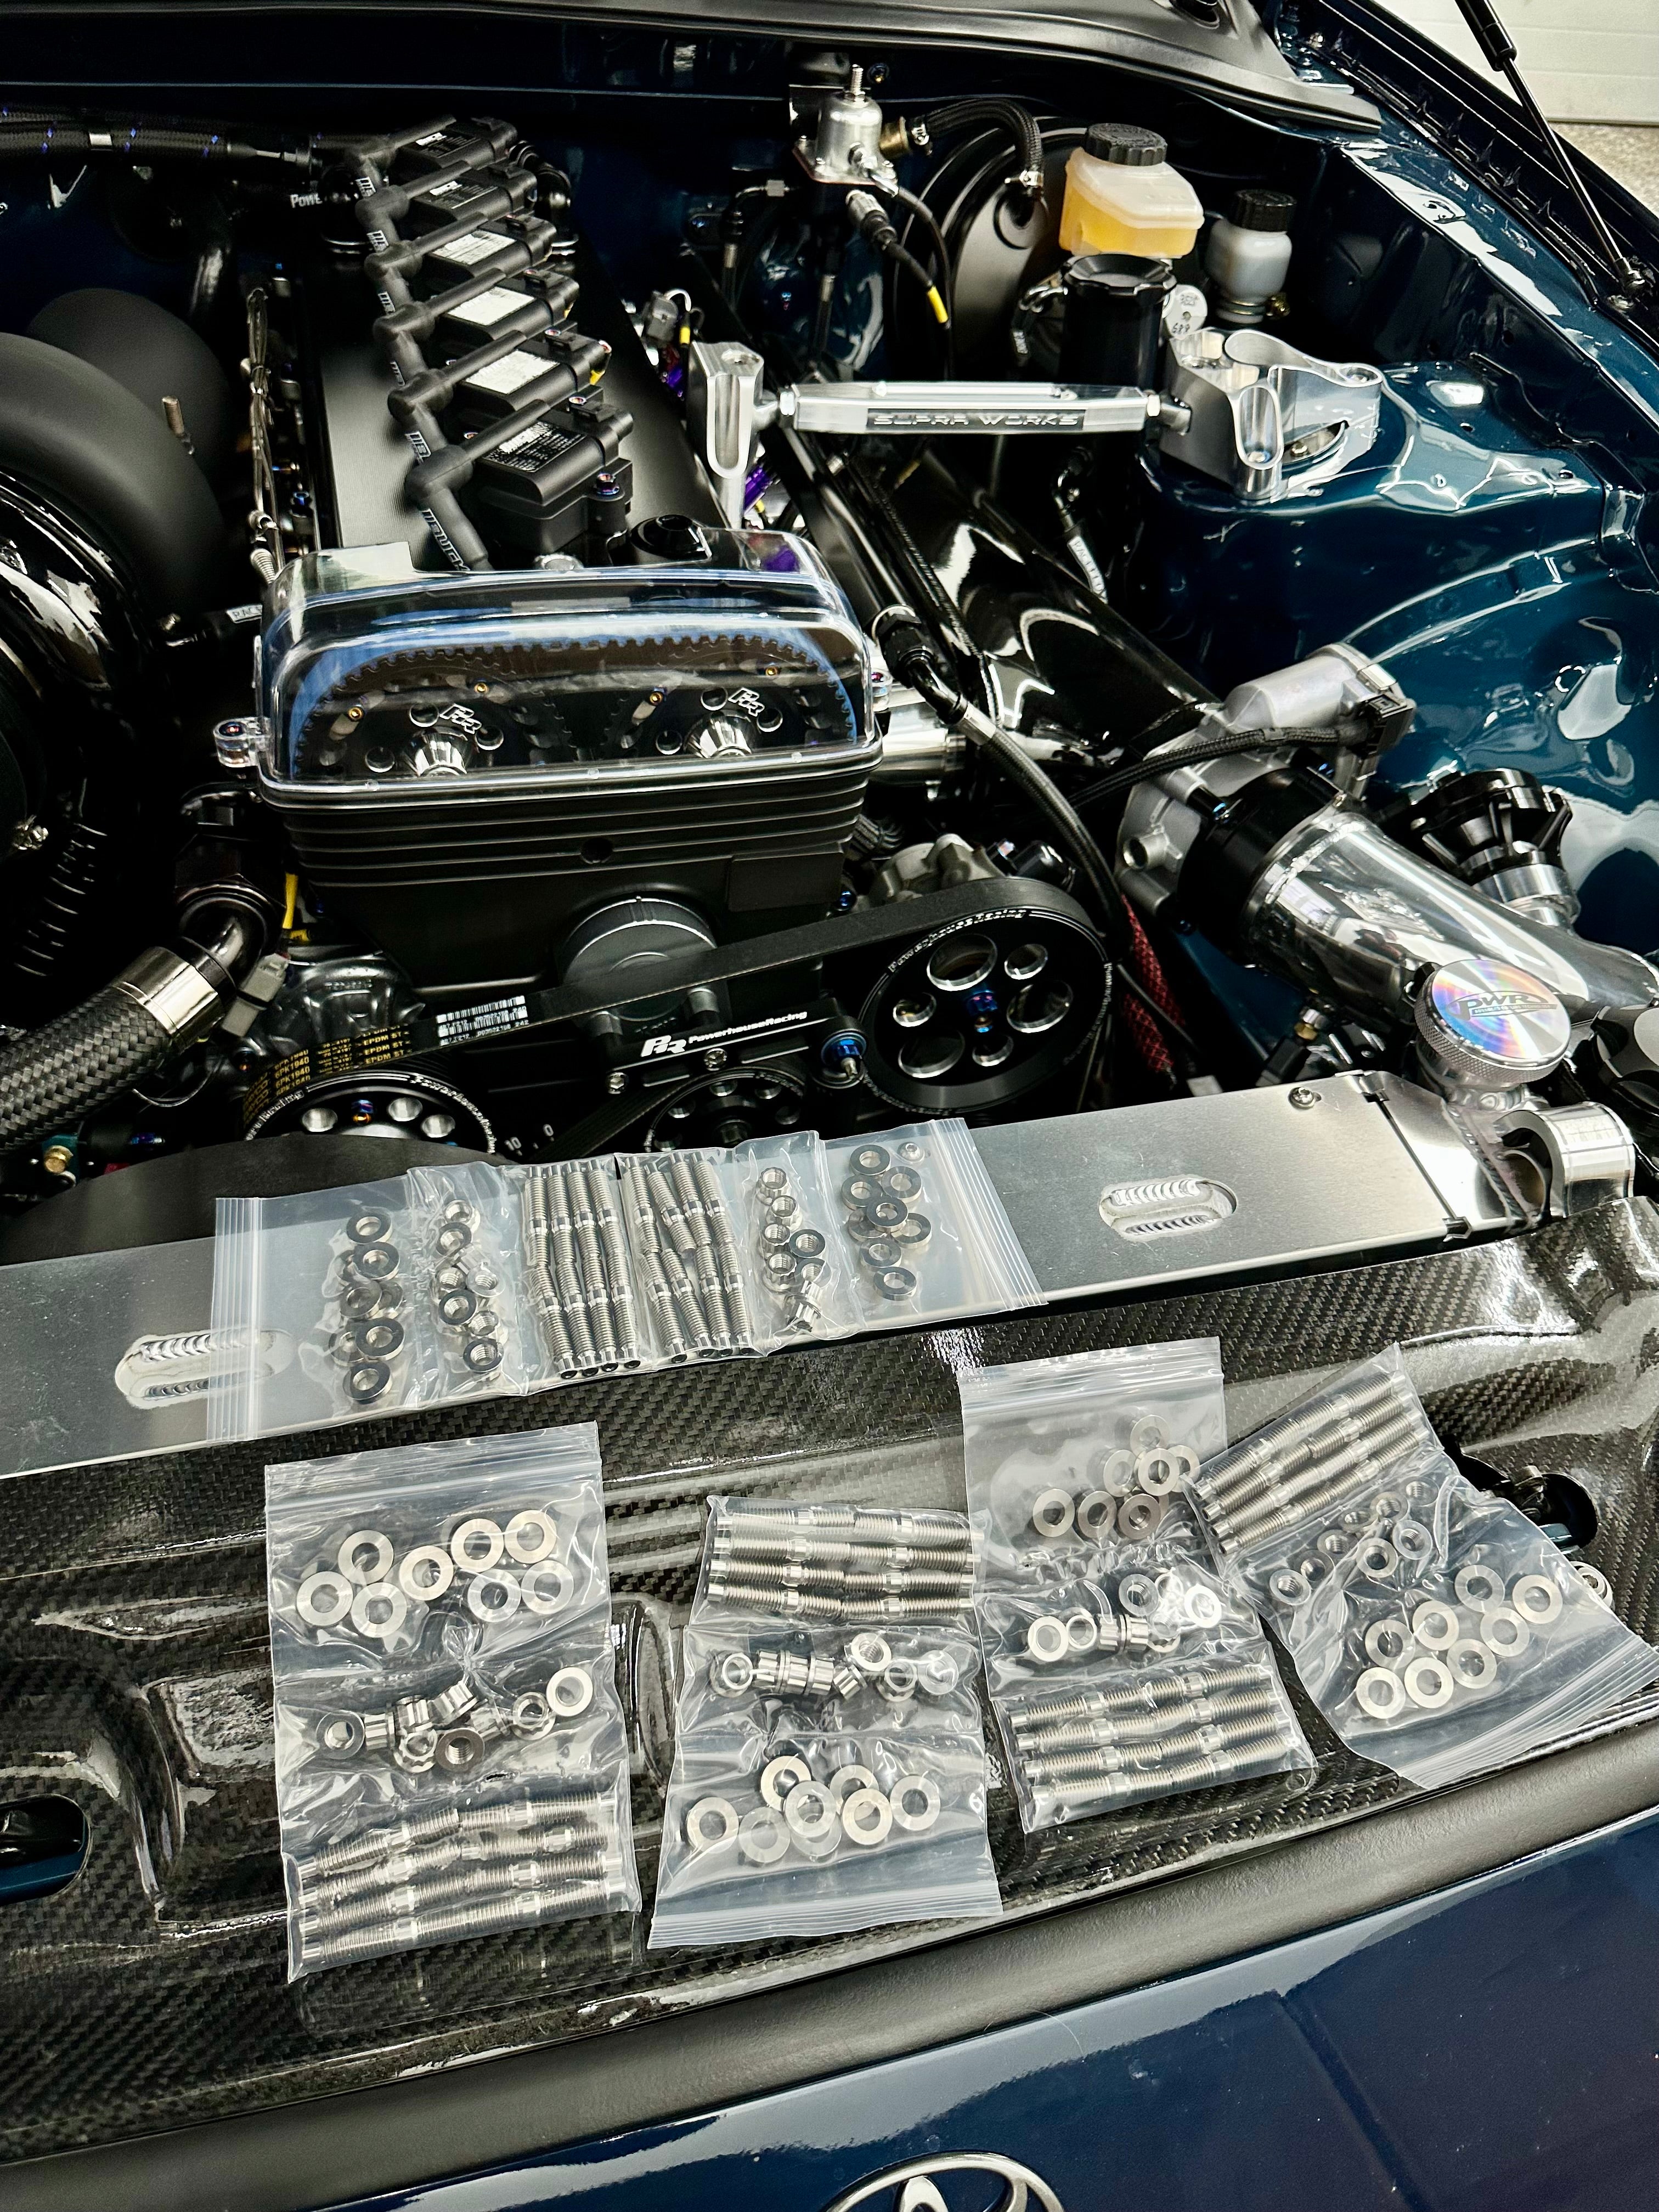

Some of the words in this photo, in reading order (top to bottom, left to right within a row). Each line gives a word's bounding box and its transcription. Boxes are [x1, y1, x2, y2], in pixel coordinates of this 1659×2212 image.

[874, 414, 969, 426] SUPRA
[979, 414, 1079, 426] WORKS
[1457, 994, 1549, 1021] PWR
[363, 1035, 389, 1046] EPDM
[364, 1044, 390, 1055] EPDM
[365, 1053, 391, 1064] EPDM
[275, 1056, 309, 1079] 6PK1940
[275, 1066, 310, 1088] 6PK1940
[543, 1124, 554, 1137] 0
[504, 1137, 522, 1150] 10
